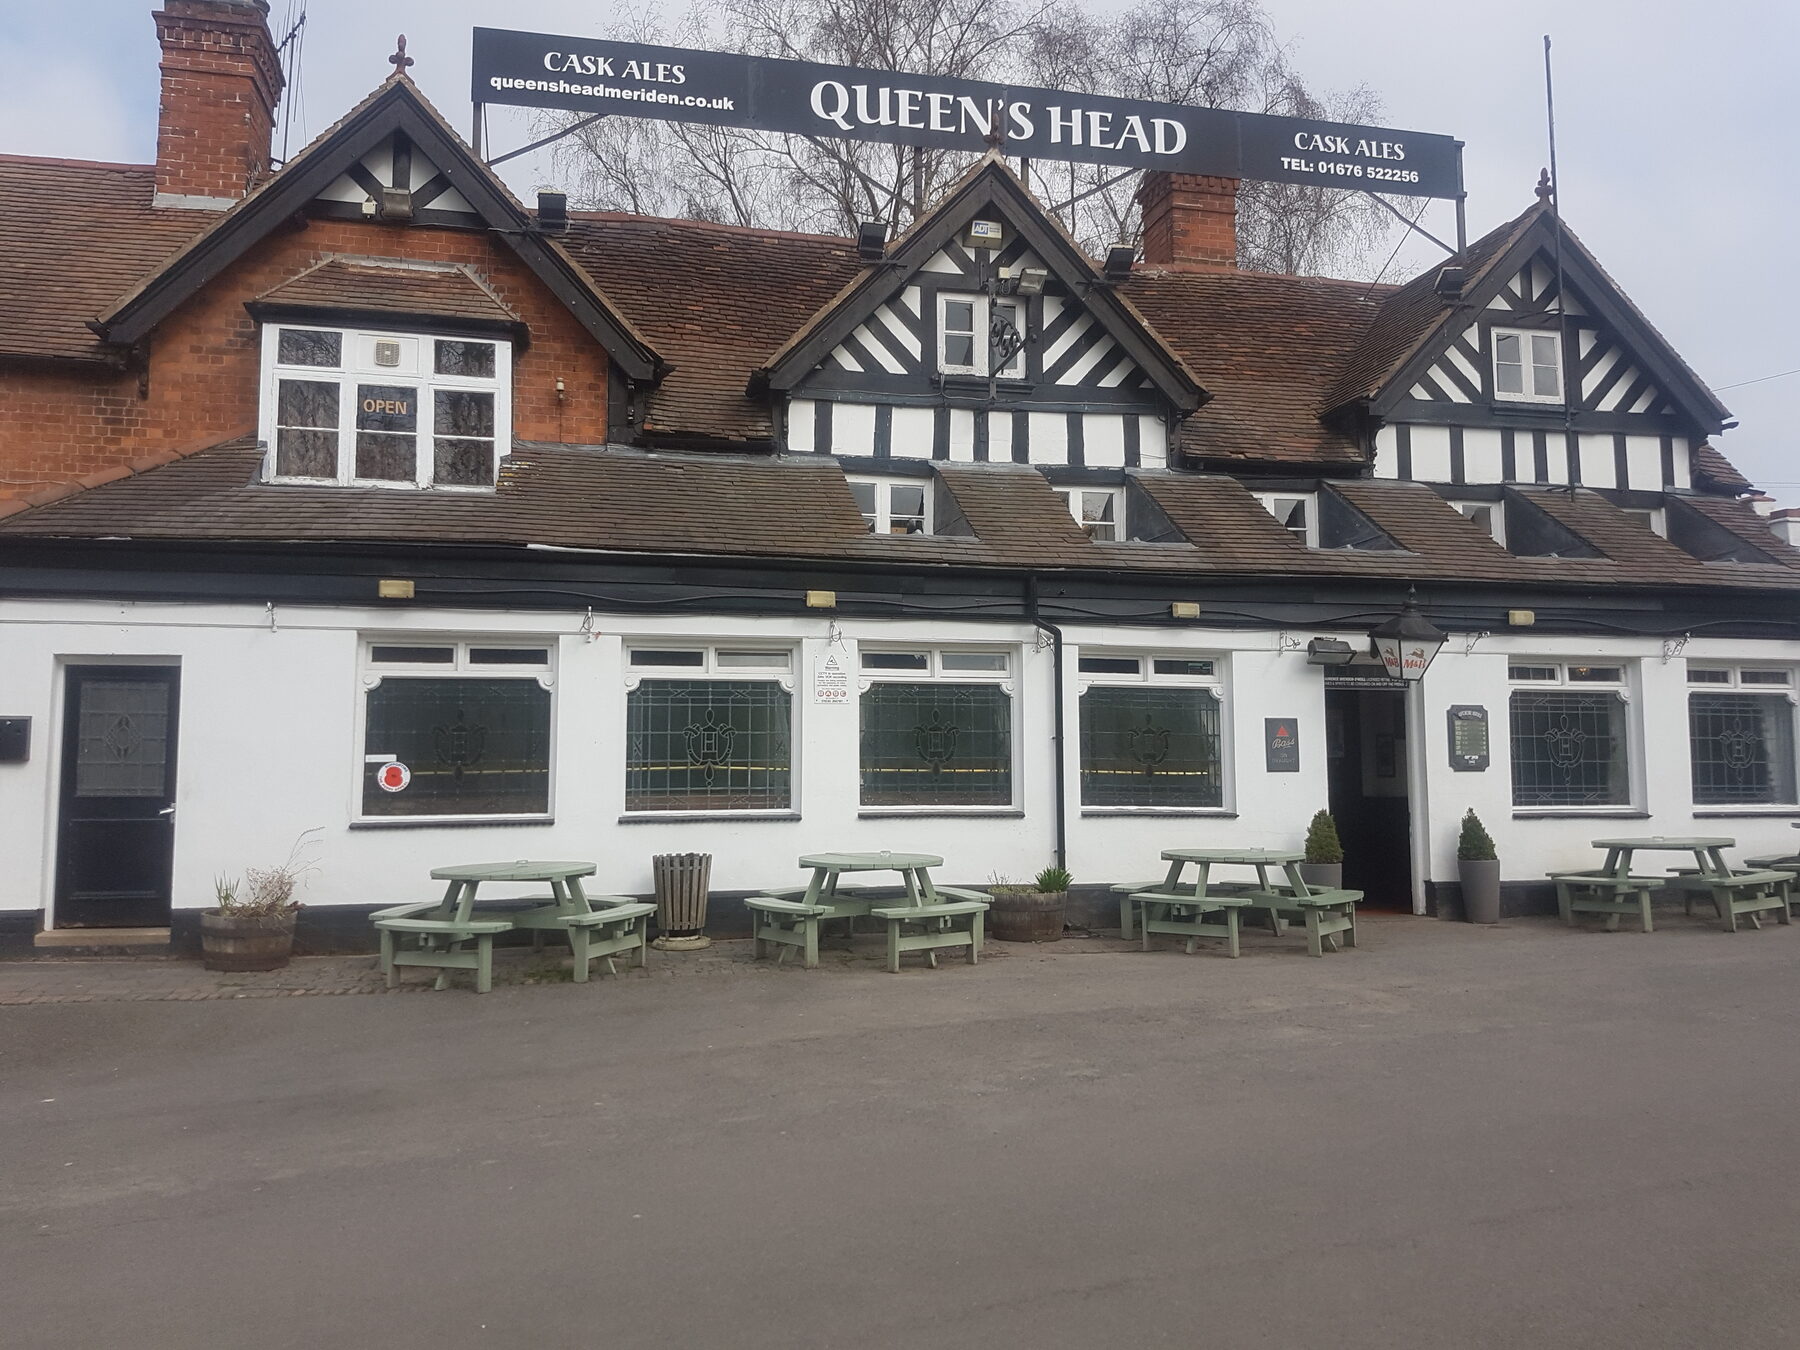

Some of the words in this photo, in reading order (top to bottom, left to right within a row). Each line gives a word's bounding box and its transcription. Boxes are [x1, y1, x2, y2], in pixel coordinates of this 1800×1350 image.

[543, 51, 615, 77] CASK
[621, 60, 686, 85] ALES
[490, 76, 735, 111] queensheadmeriden.co.uk
[810, 80, 1035, 140] QUEEN'S
[1046, 105, 1187, 155] HEAD
[1294, 132, 1350, 155] CASK
[1354, 139, 1405, 161] ALES
[1281, 157, 1314, 172] TEL:
[1318, 161, 1363, 177] 01676
[1366, 166, 1419, 183] 522256
[974, 224, 988, 235] ADT
[363, 399, 407, 415] OPEN
[1272, 737, 1295, 749] Bass
